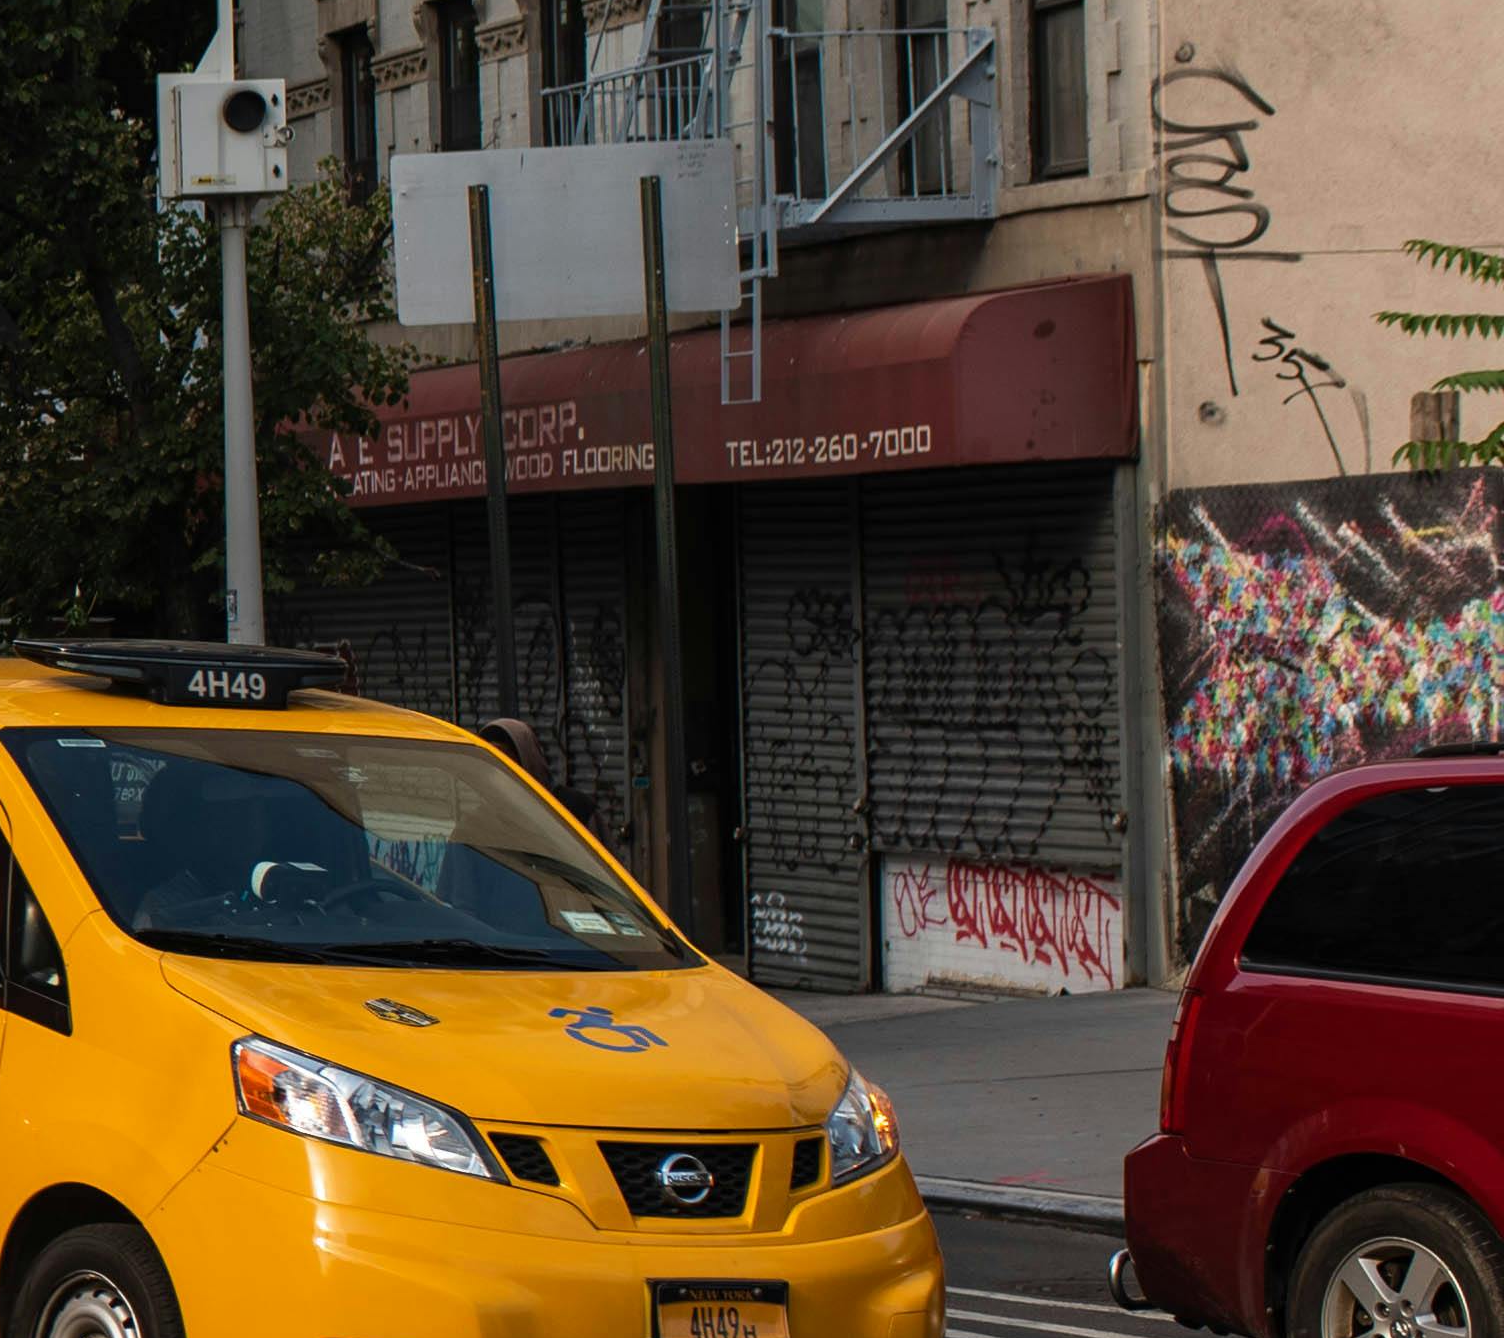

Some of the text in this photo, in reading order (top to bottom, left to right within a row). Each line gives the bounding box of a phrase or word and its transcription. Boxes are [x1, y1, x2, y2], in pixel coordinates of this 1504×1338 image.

[387, 414, 481, 462] SUPPLY
[503, 401, 585, 451] CORP.
[562, 443, 655, 476] FLOORING
[187, 669, 266, 700] 4H49
[689, 1290, 754, 1301] NEW YORK
